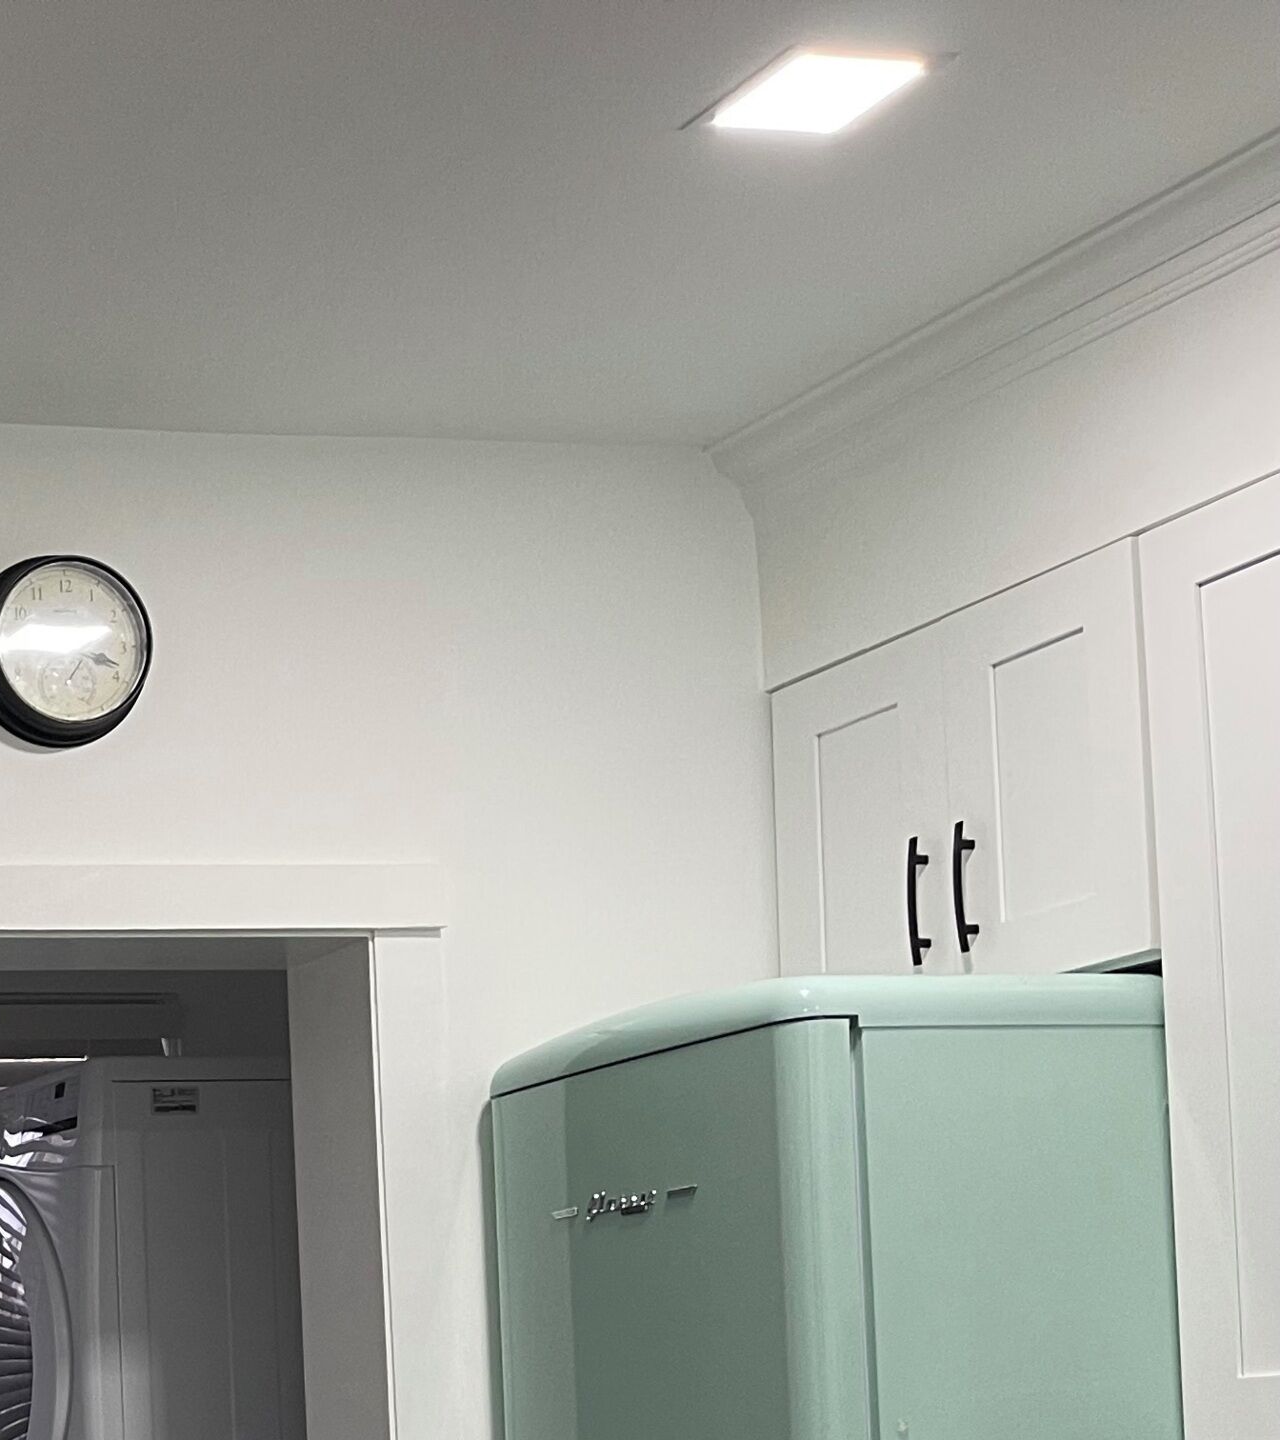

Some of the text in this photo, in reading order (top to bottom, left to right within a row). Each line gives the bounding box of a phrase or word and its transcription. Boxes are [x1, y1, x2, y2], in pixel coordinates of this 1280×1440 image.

[59, 579, 73, 593] 12
[31, 587, 42, 601] 11
[14, 607, 27, 621] 10
[110, 610, 117, 624] 2
[120, 641, 127, 655] 3
[112, 670, 119, 683] 4
